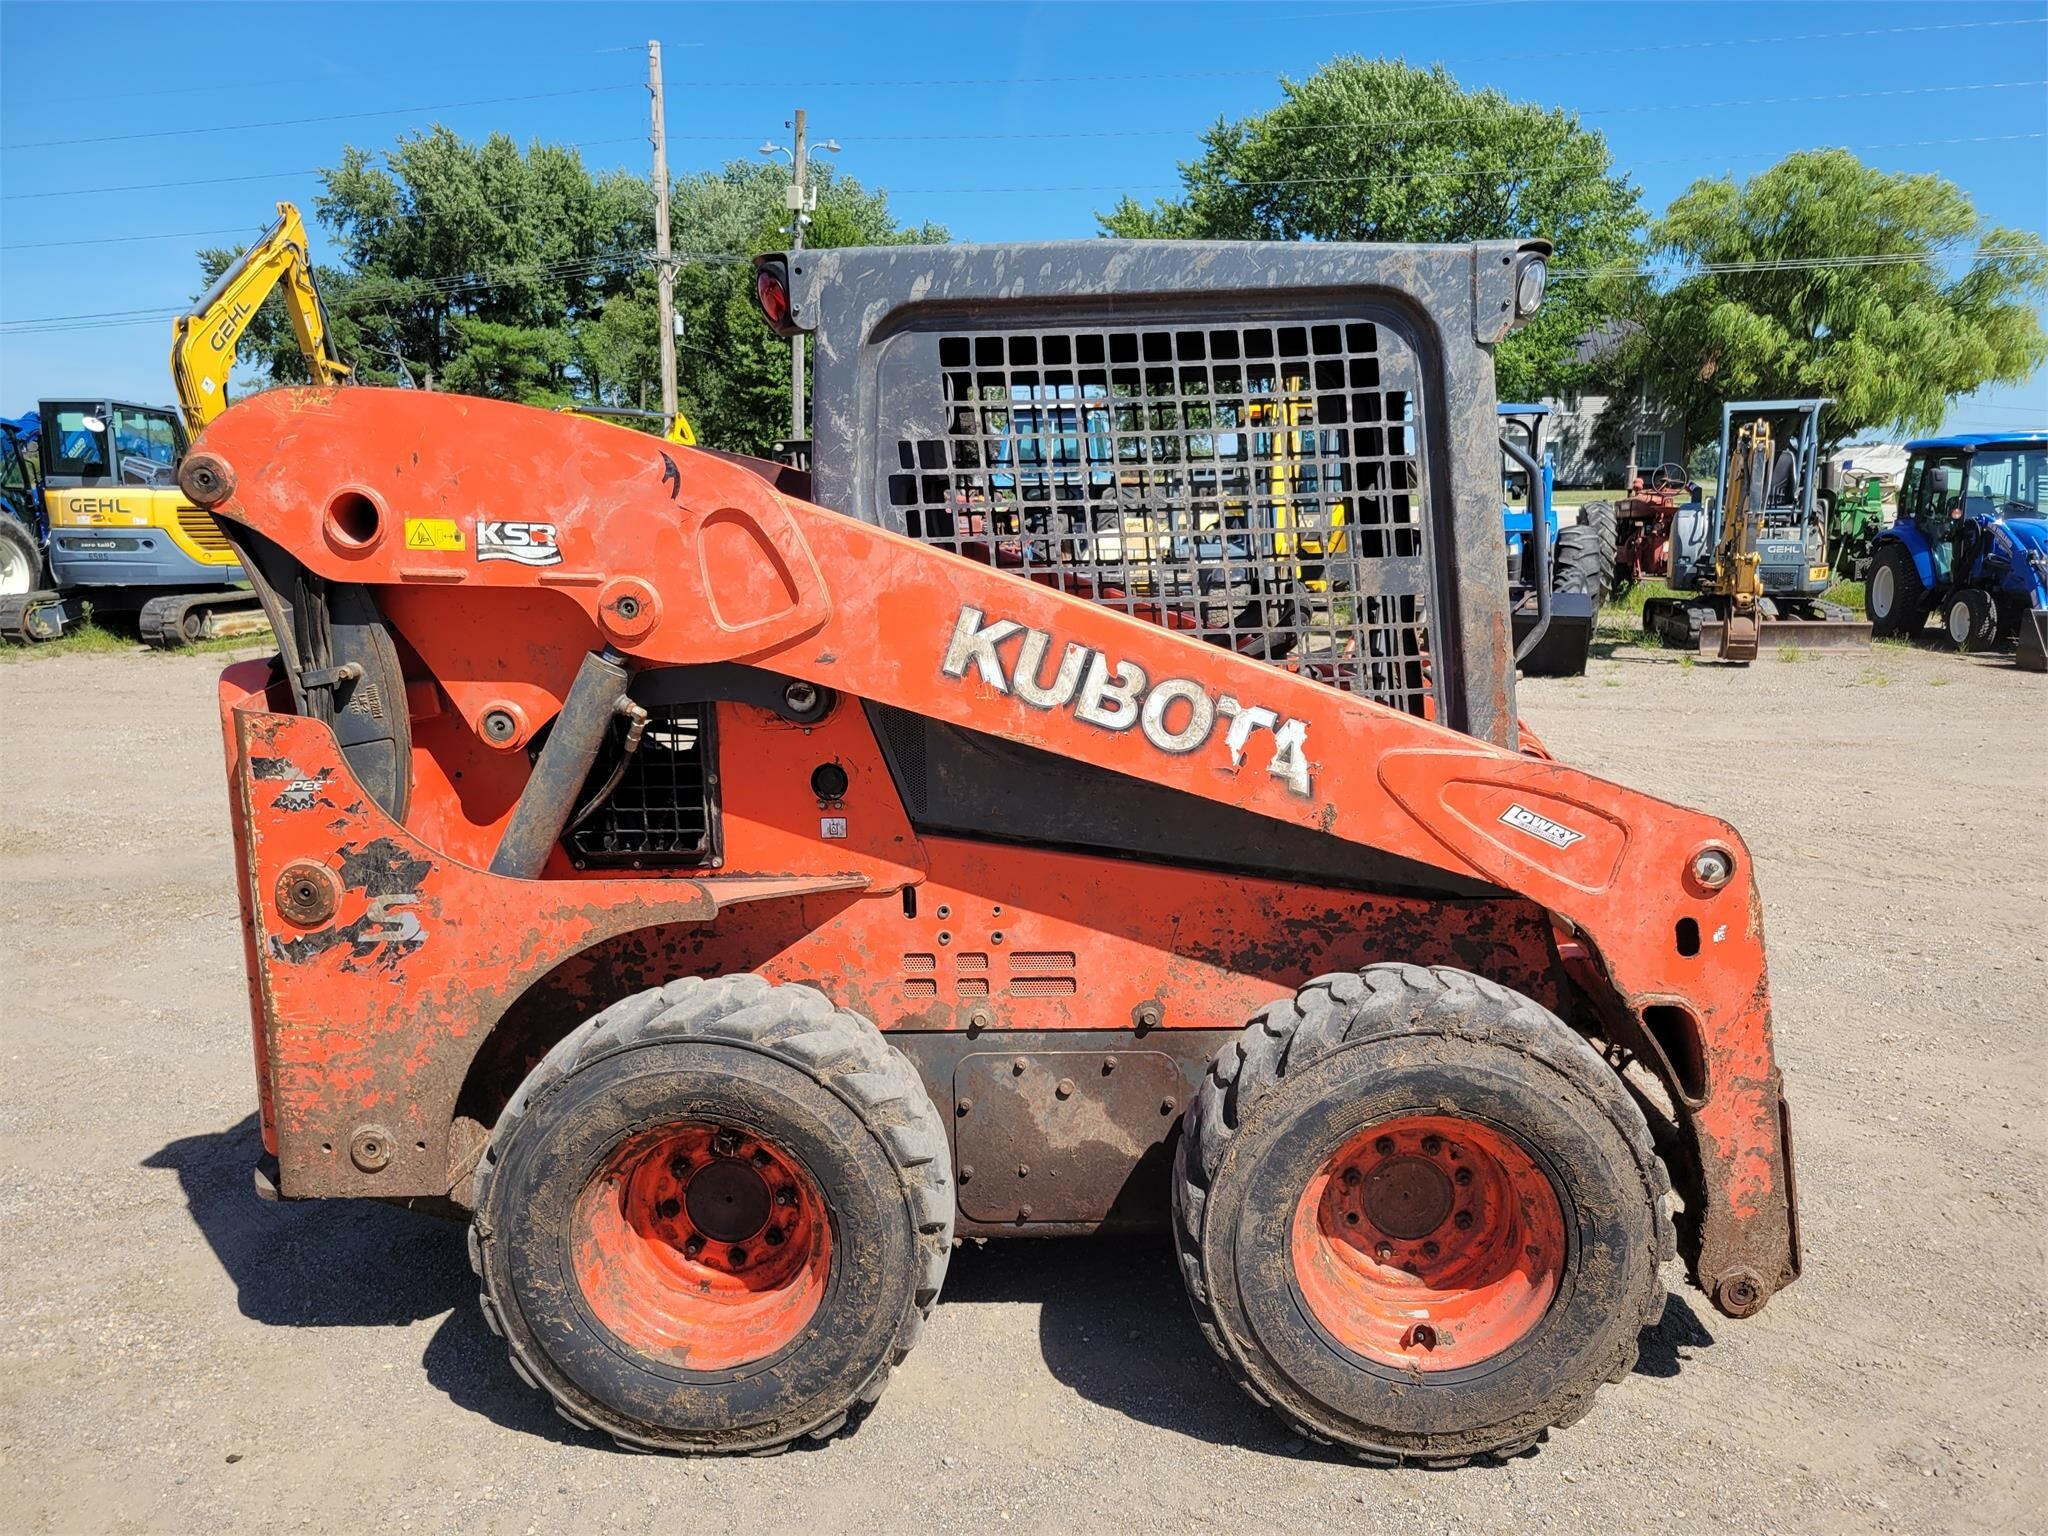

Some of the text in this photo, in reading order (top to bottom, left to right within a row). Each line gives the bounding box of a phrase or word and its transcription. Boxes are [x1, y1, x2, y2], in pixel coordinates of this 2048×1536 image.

[211, 302, 251, 351] GEHL
[69, 498, 131, 513] GEHL
[1767, 545, 1800, 553] GEHL
[942, 604, 1312, 797] KUBOTA
[1501, 805, 1581, 838] LOWRY
